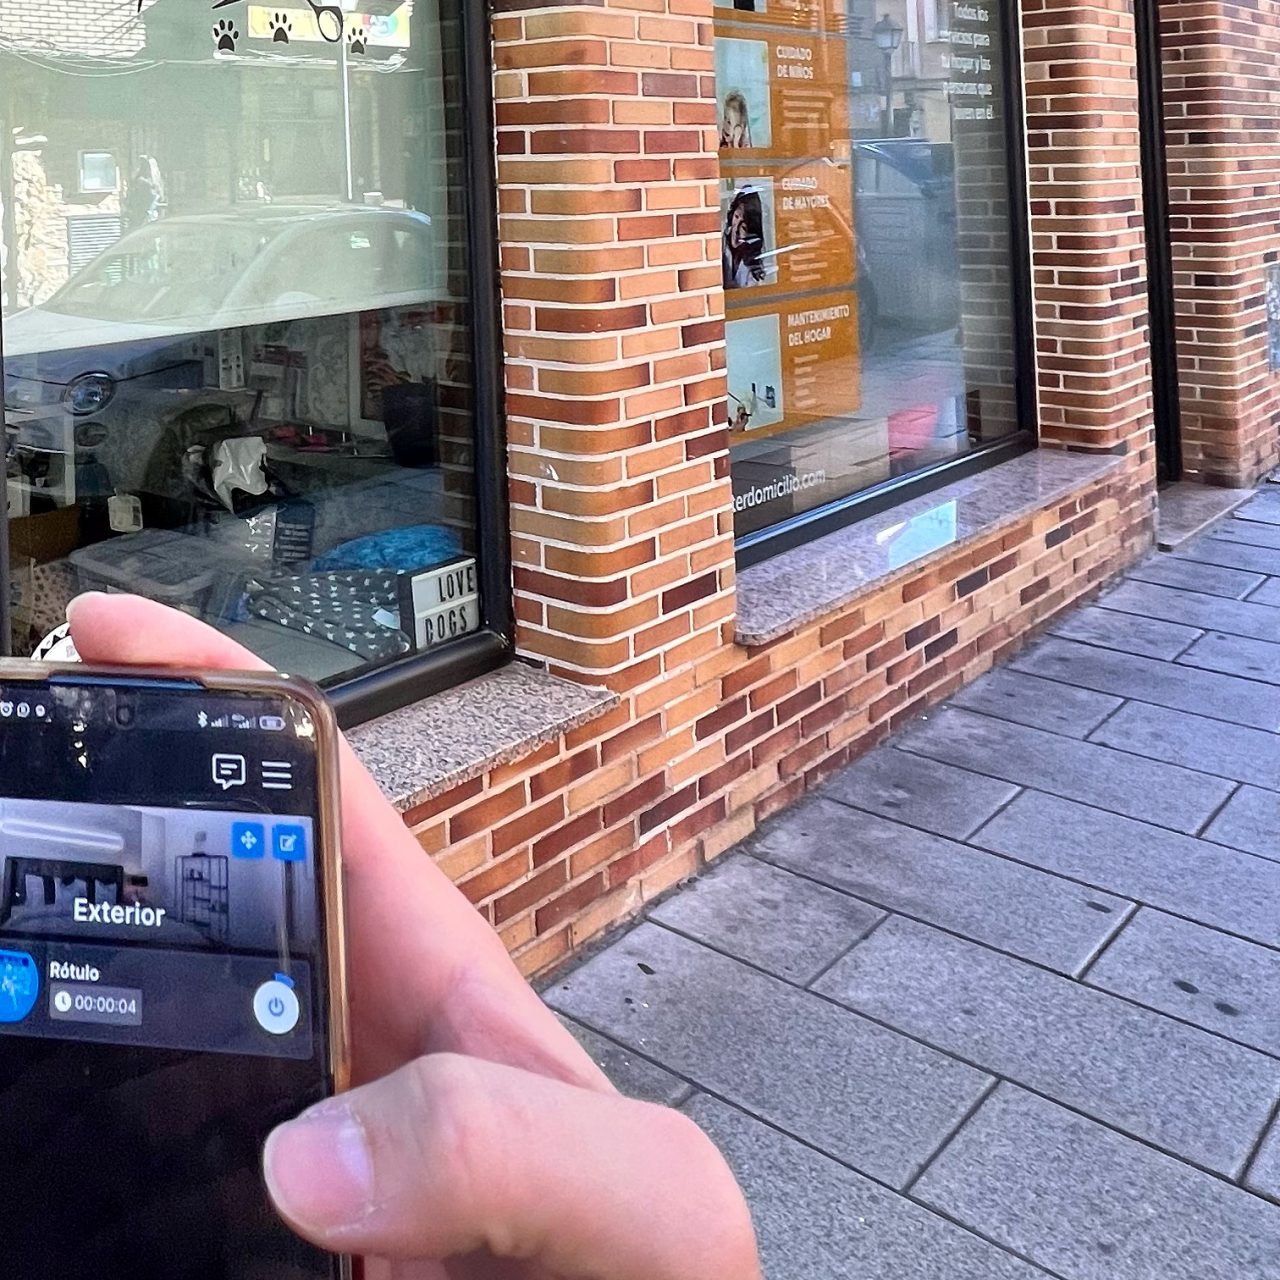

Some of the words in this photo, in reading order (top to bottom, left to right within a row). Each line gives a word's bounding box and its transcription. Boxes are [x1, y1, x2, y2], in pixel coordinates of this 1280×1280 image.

[776, 45, 813, 62] CUIDADO
[777, 66, 789, 79] DE
[787, 304, 850, 327] MANTENIMIENTO
[788, 332, 803, 347] DEL
[804, 325, 832, 344] HOGAR
[730, 468, 826, 513] erdomicilio.com
[438, 566, 475, 602] LOVE
[424, 606, 468, 645] DOGS
[73, 897, 166, 928] Exterior
[50, 960, 100, 982] Rótulo
[74, 994, 137, 1015] 00:00:04
